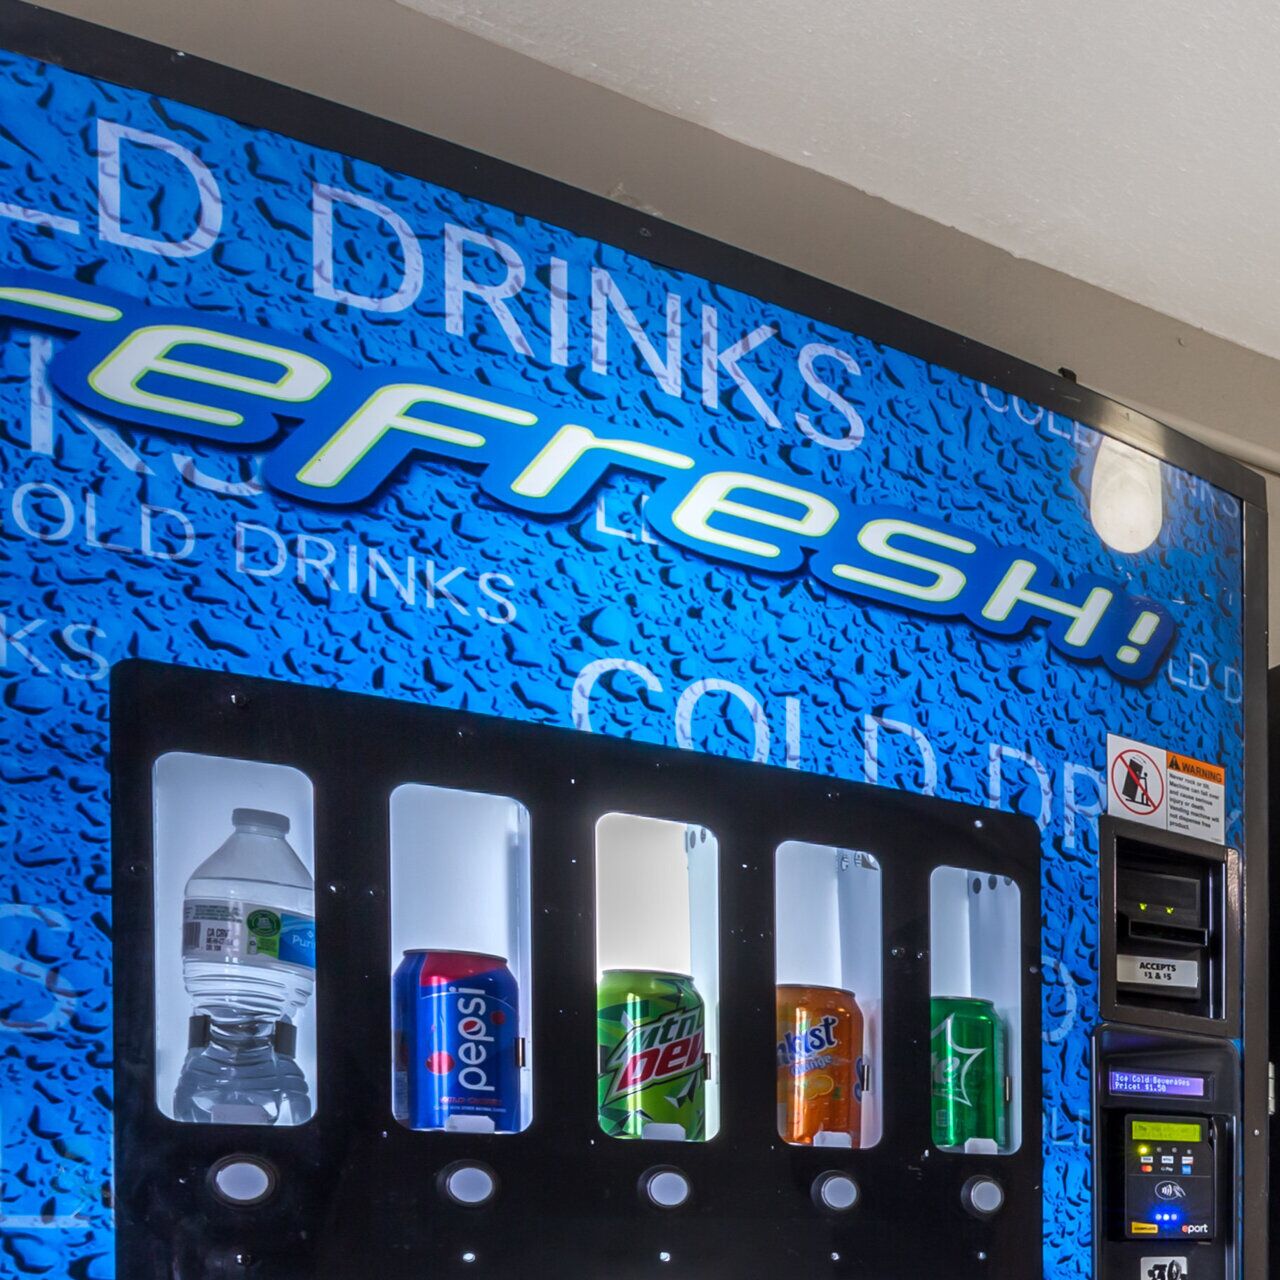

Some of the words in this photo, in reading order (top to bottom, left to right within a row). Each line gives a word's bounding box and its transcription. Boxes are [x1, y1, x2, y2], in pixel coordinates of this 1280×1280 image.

[311, 180, 866, 453] DRINKS
[0, 482, 196, 560] OLD
[234, 520, 518, 627] DRINKS
[1182, 761, 1223, 784] WARNING
[1139, 962, 1177, 973] ACCEPTS
[448, 987, 495, 1092] pepsi
[1115, 1074, 1129, 1082] Ice
[1132, 1075, 1150, 1084] Cold
[1153, 1076, 1191, 1087] Beverages
[1145, 1083, 1167, 1093] $1.50
[1182, 1223, 1208, 1234] eport
